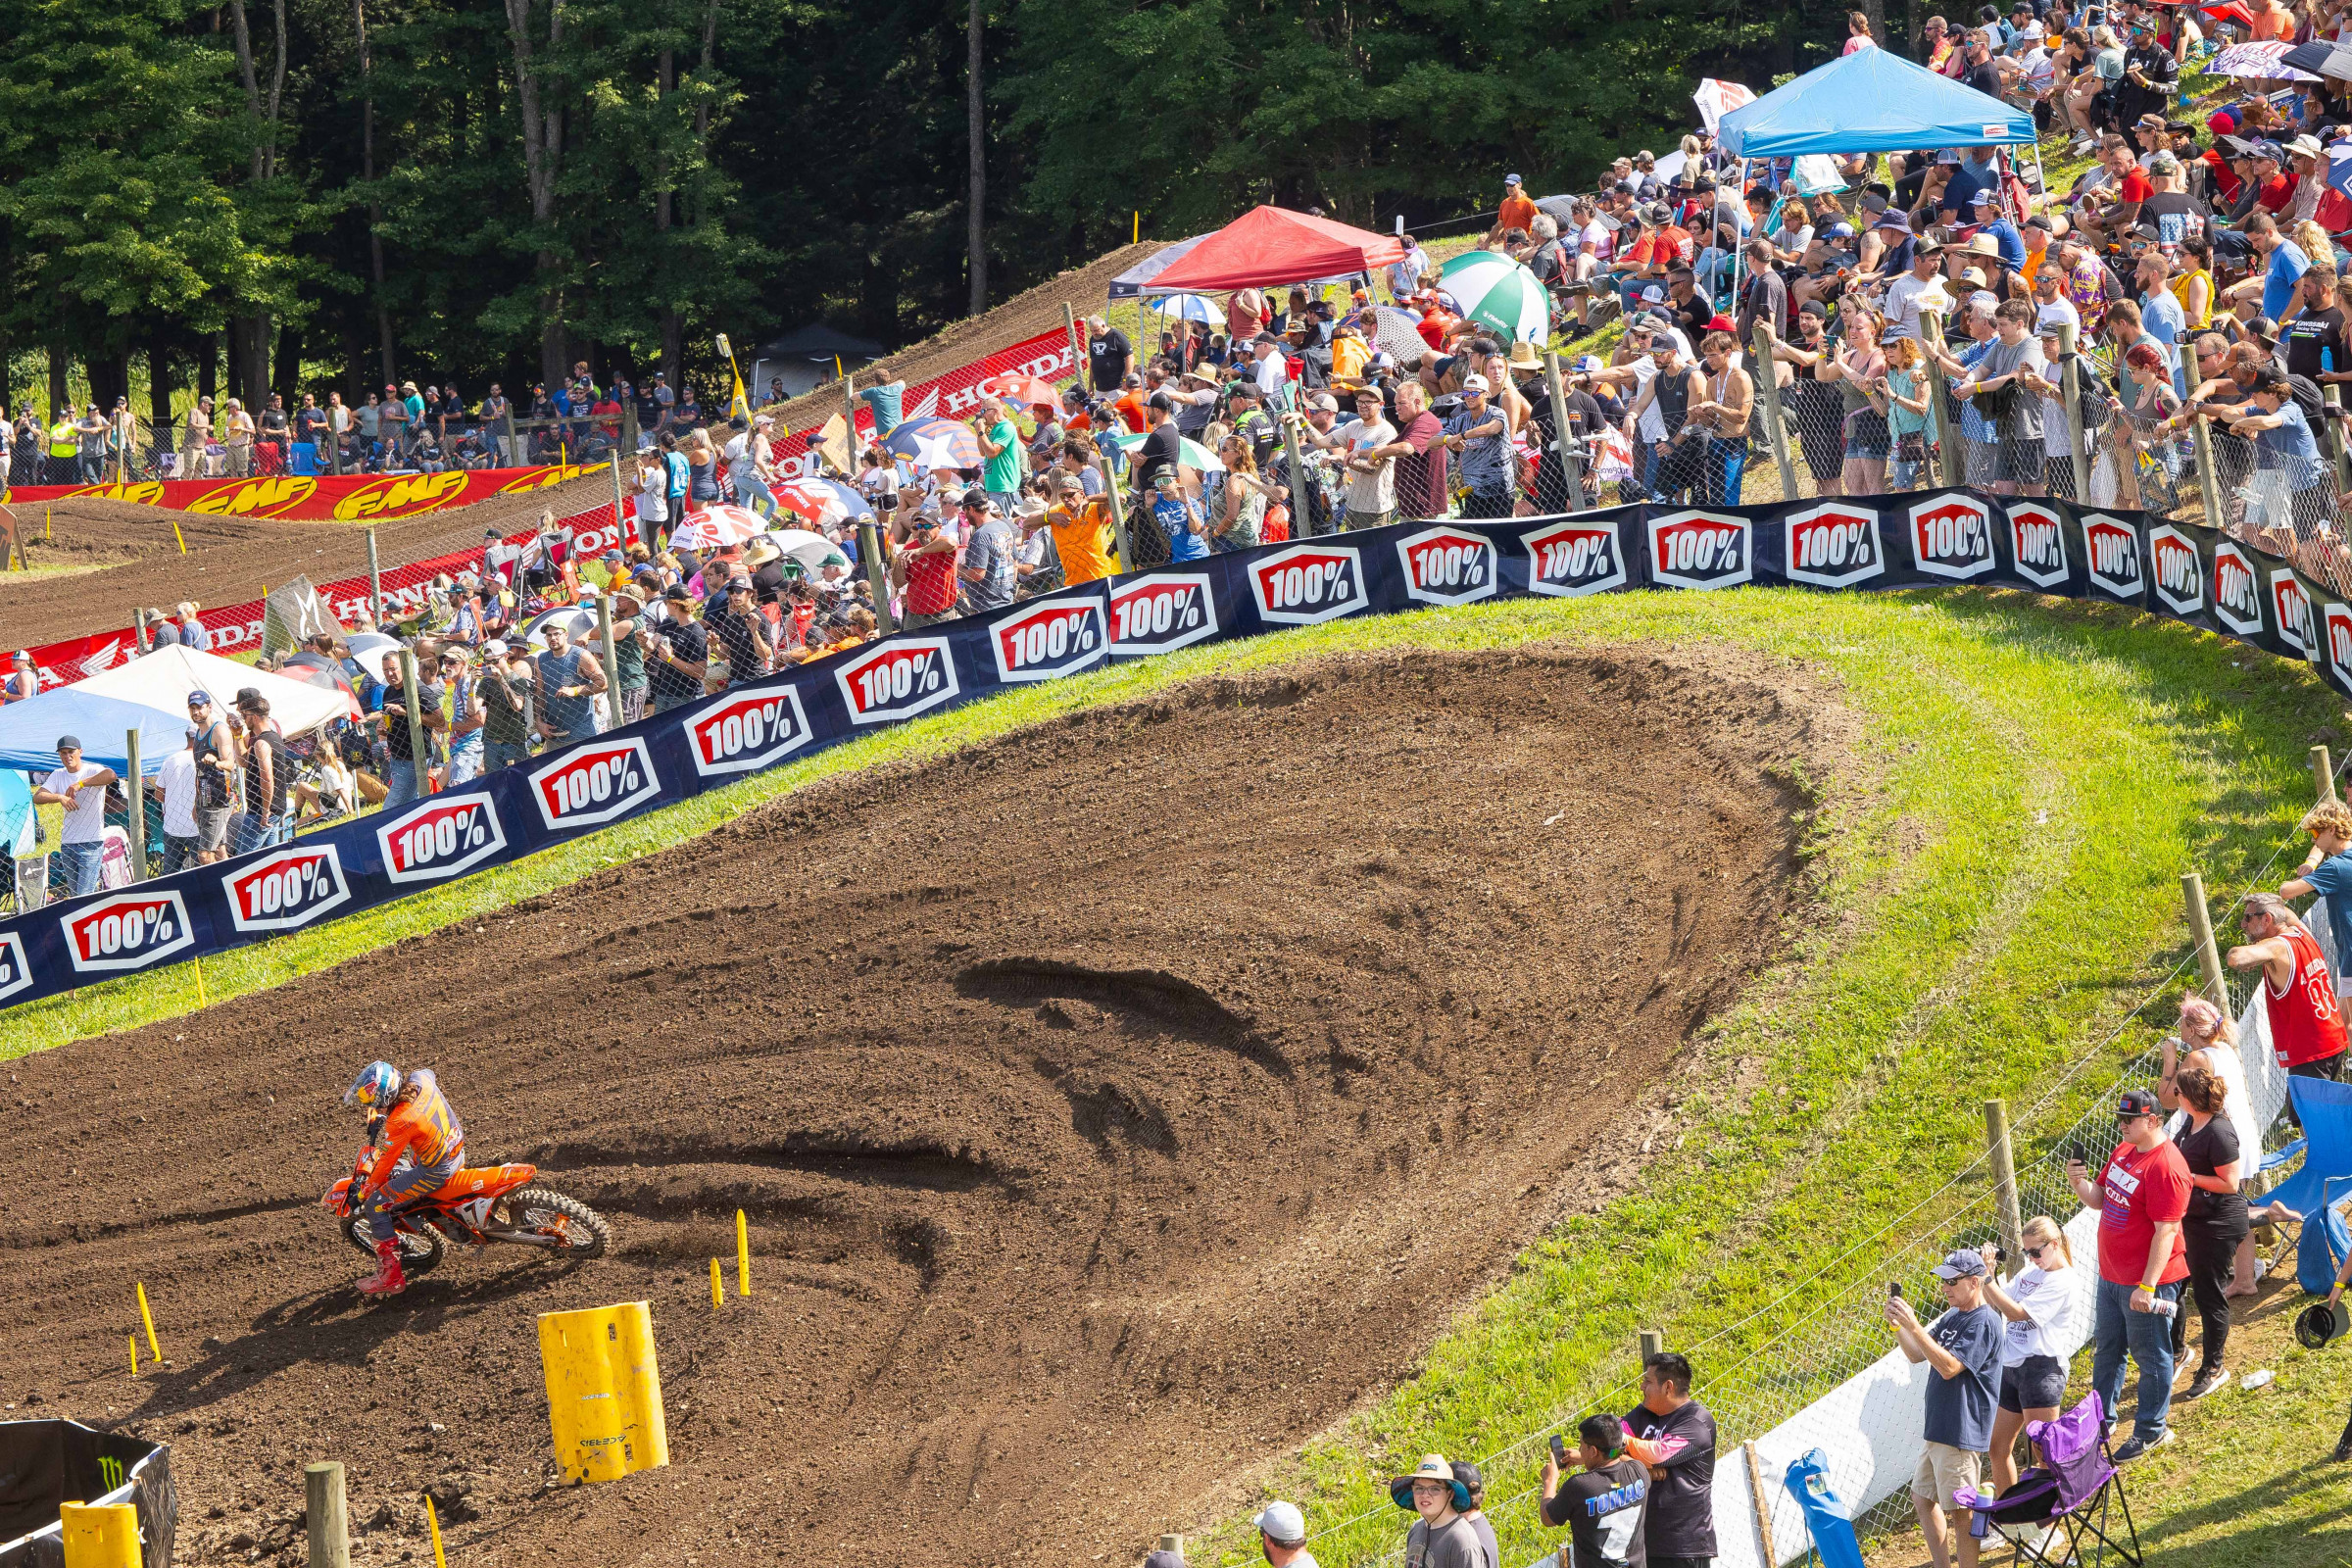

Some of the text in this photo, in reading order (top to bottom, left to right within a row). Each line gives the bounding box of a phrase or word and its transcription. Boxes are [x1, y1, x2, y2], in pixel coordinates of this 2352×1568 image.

[2295, 320, 2329, 329] Kawasaki
[189, 476, 314, 514] FMF
[342, 470, 465, 519] FMF
[1541, 535, 1610, 578] 100%
[1665, 529, 1737, 570] 100%
[1799, 522, 1869, 566] 100%
[1925, 514, 1984, 558] 100%
[2020, 522, 2059, 567] 100%
[2093, 532, 2135, 578] 100%
[1269, 560, 1348, 608] 100%
[1416, 542, 1483, 586] 100%
[2158, 546, 2196, 595] 100%
[2220, 563, 2255, 616] 100%
[1010, 610, 1095, 667] 100%
[1115, 592, 1200, 641] 100%
[858, 651, 938, 705] 100%
[705, 698, 791, 760] 100%
[551, 749, 638, 817] 100%
[398, 803, 485, 870] 100%
[245, 856, 328, 916] 100%
[83, 901, 173, 958] 100%
[1585, 1478, 1645, 1517] TOMAC
[1596, 1504, 1642, 1559] 7
